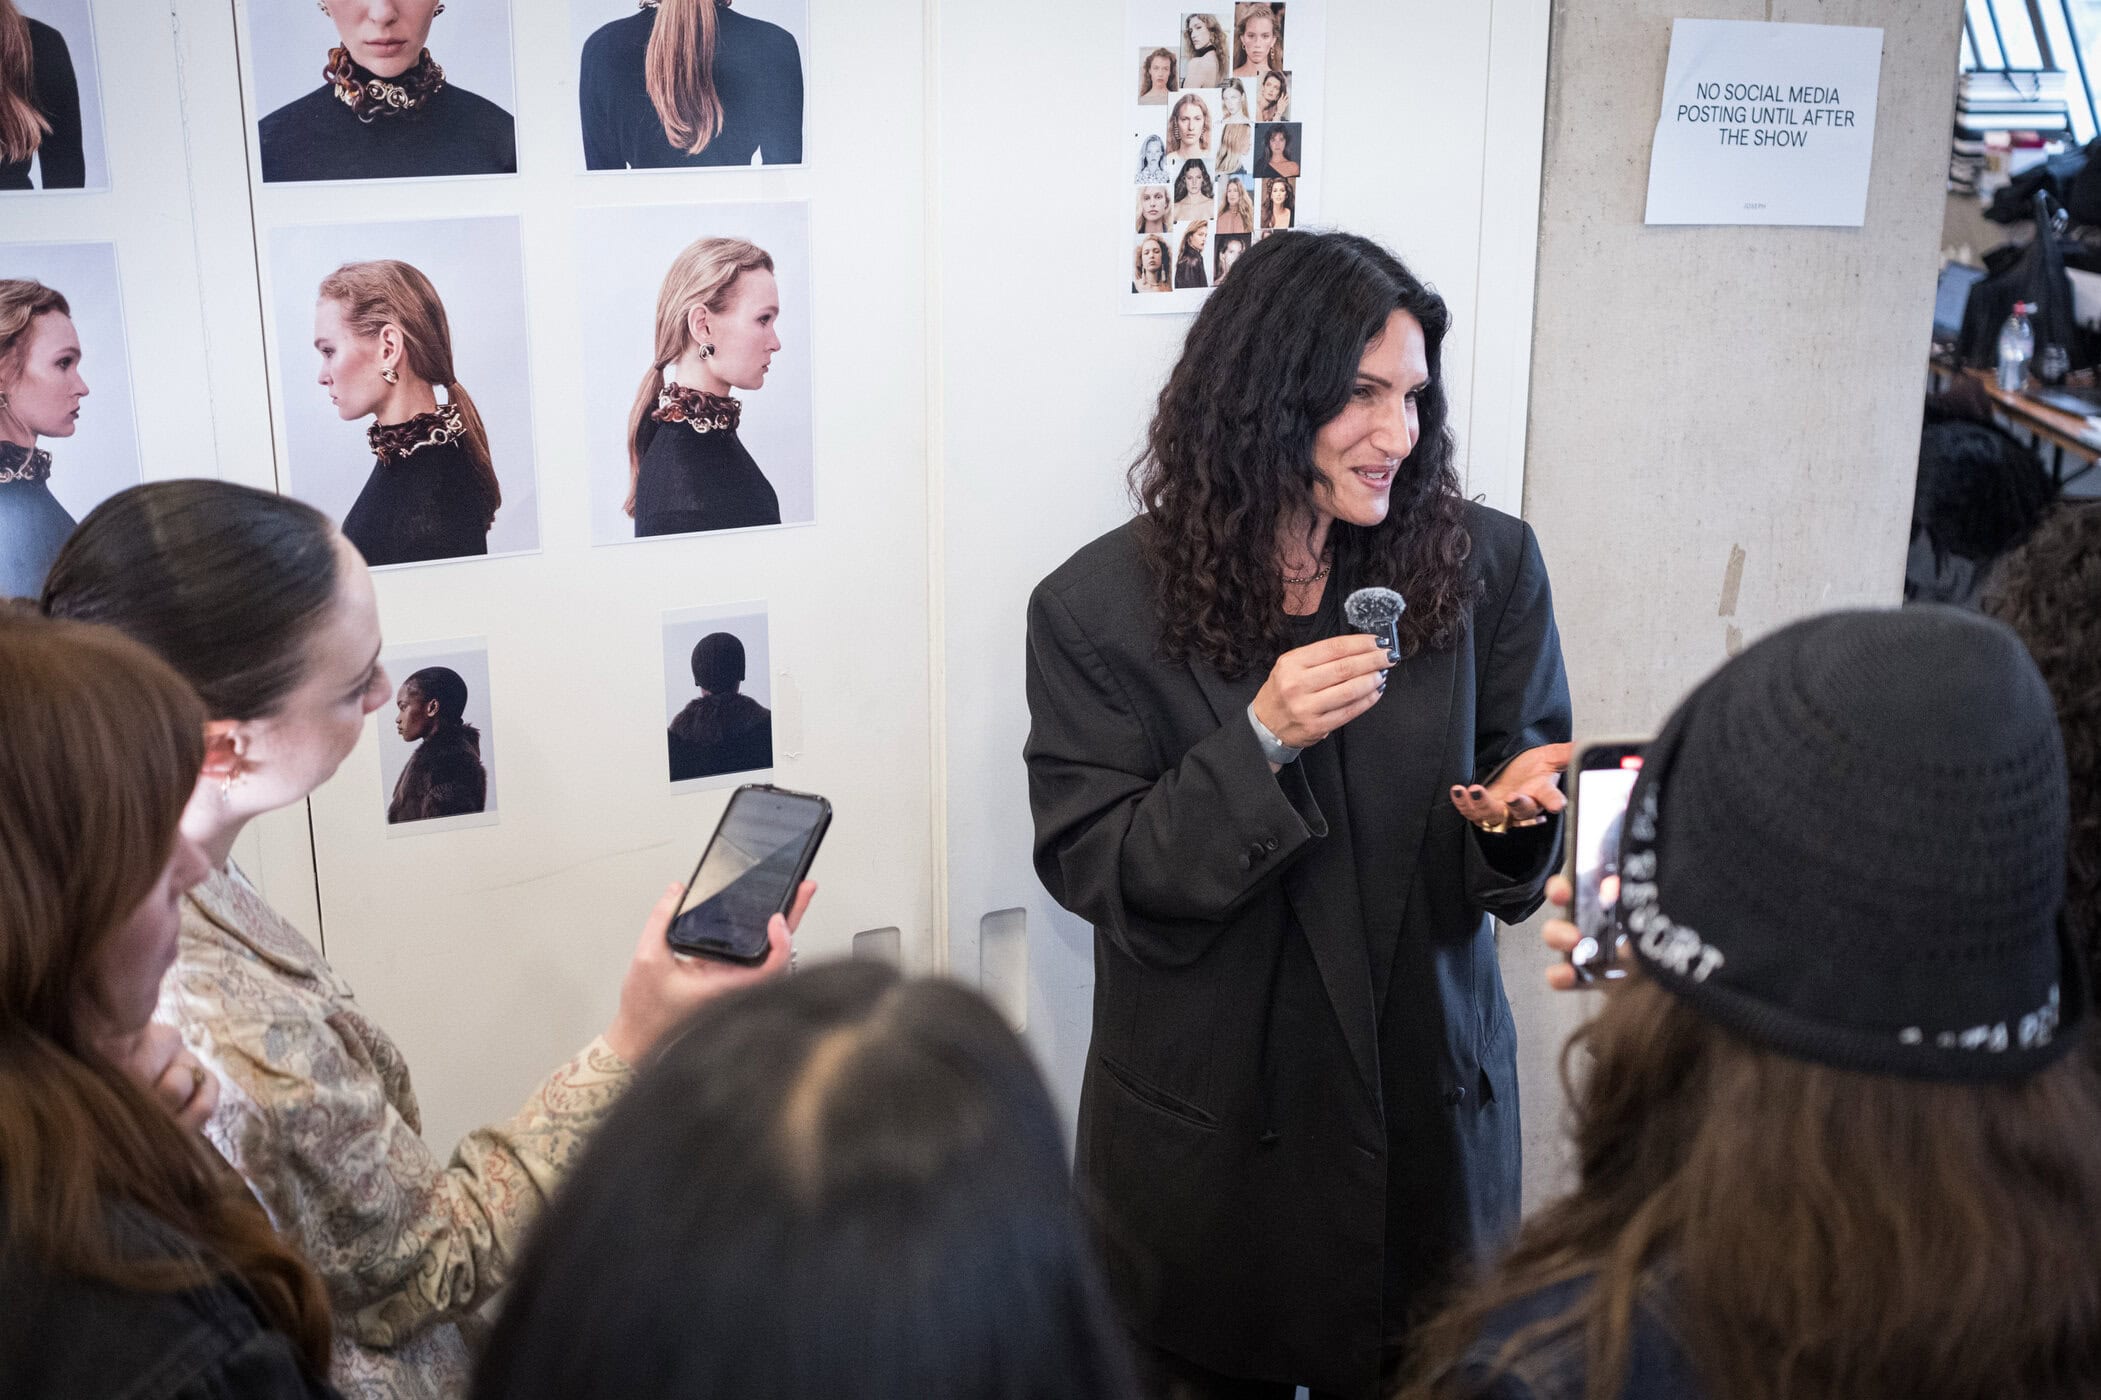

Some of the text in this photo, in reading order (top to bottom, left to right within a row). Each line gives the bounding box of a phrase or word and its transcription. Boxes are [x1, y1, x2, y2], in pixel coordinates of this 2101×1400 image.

[1696, 83, 1840, 104] NO SOCIAL MEDIA
[1677, 105, 1855, 127] POSTING UNTIL AFTER
[1719, 128, 1807, 147] THE SHOW
